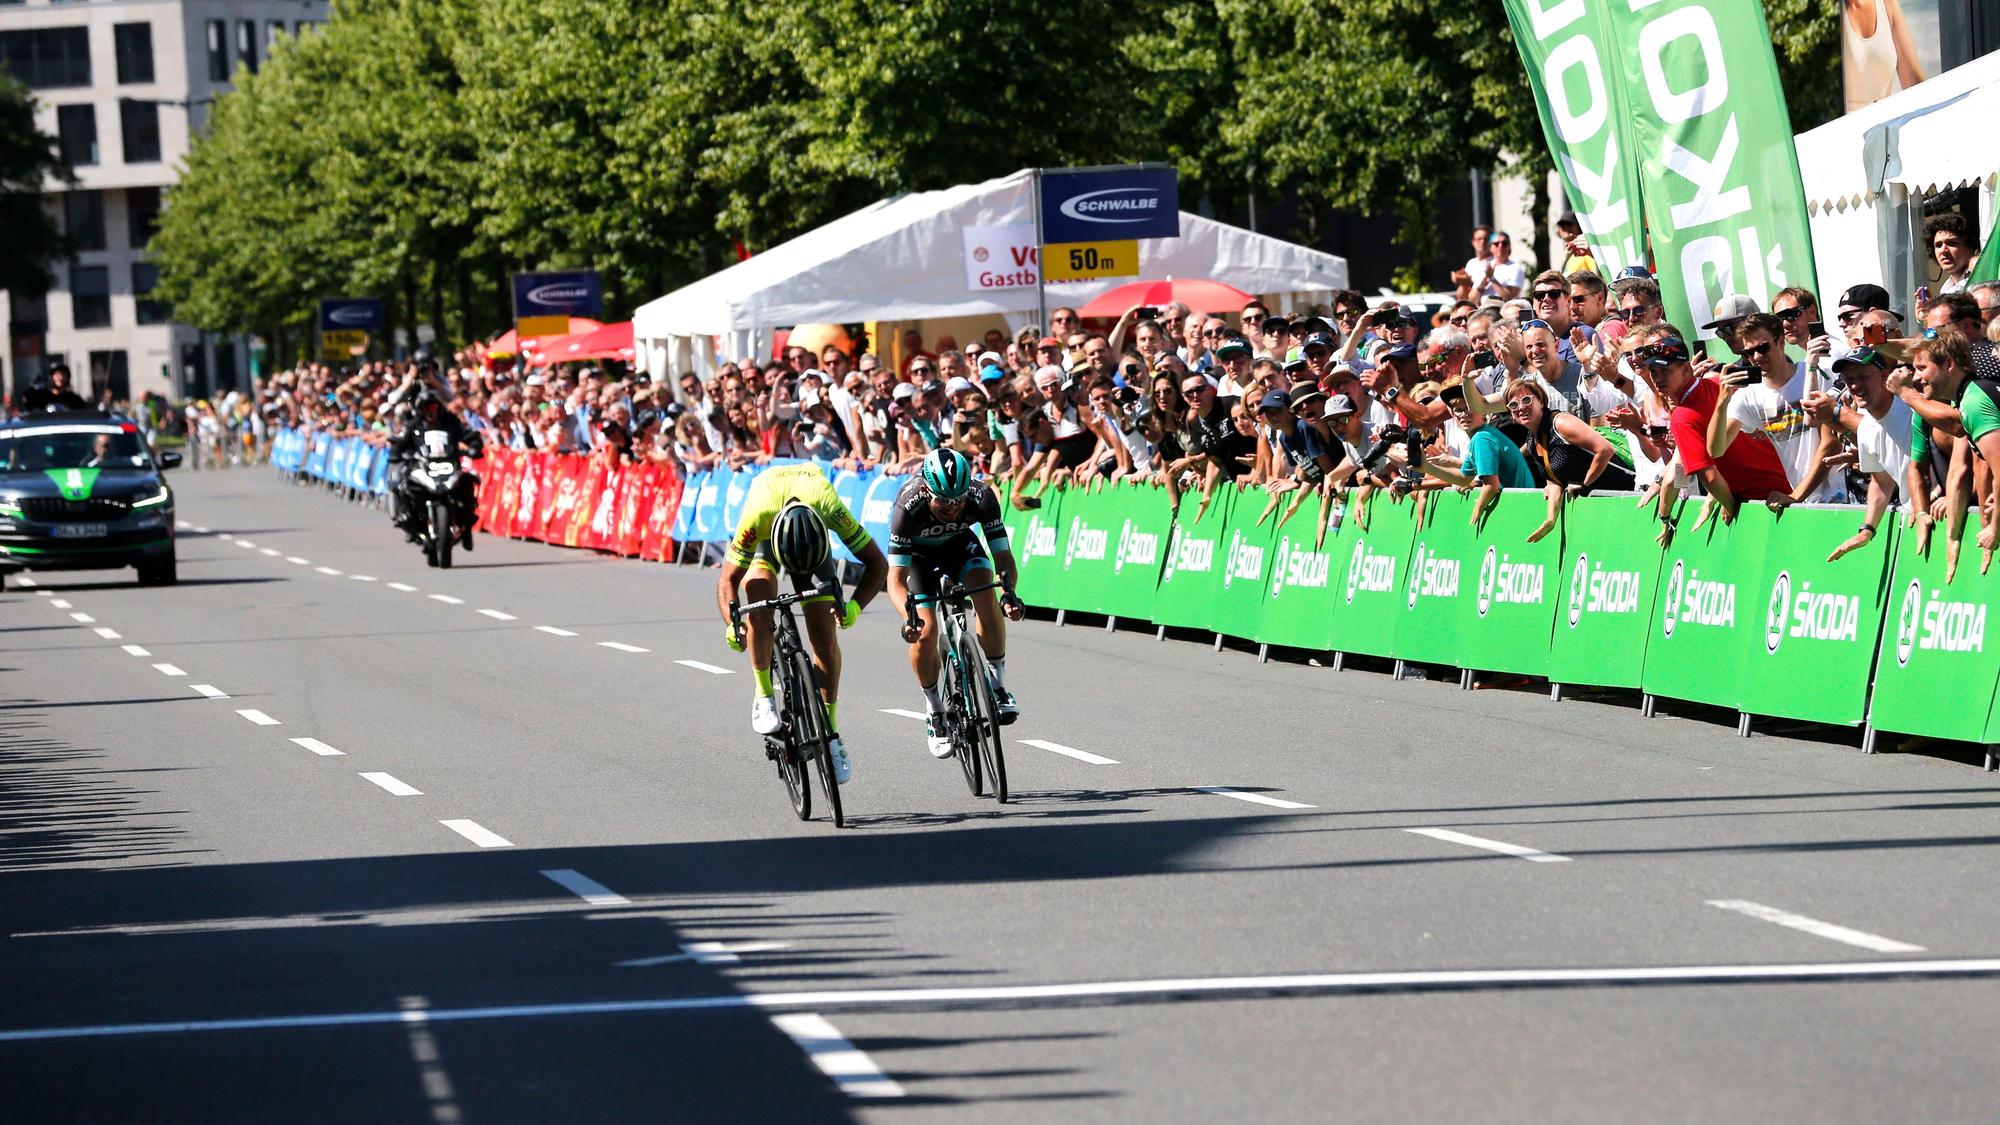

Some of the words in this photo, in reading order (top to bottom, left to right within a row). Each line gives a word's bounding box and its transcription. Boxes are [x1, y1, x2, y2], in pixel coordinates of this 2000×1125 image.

[1077, 198, 1159, 212] SCHWALBE
[1069, 247, 1098, 271] 50
[1100, 257, 1114, 270] m
[919, 522, 969, 538] BORA
[1074, 521, 1108, 561] ŠKODA
[1125, 524, 1158, 566] ŠKODA
[1177, 531, 1214, 573] ŠKODA
[1234, 536, 1264, 581] ŠKODA
[1285, 542, 1331, 588] ŠKODA
[1357, 545, 1397, 593] ŠKODA
[1421, 549, 1461, 598] ŠKODA
[1495, 554, 1545, 605] ŠKODA
[1587, 560, 1641, 614] ŠKODA
[1681, 568, 1736, 628] ŠKODA
[1790, 581, 1860, 642] ŠKODA
[1918, 588, 1988, 653] ŠKODA
